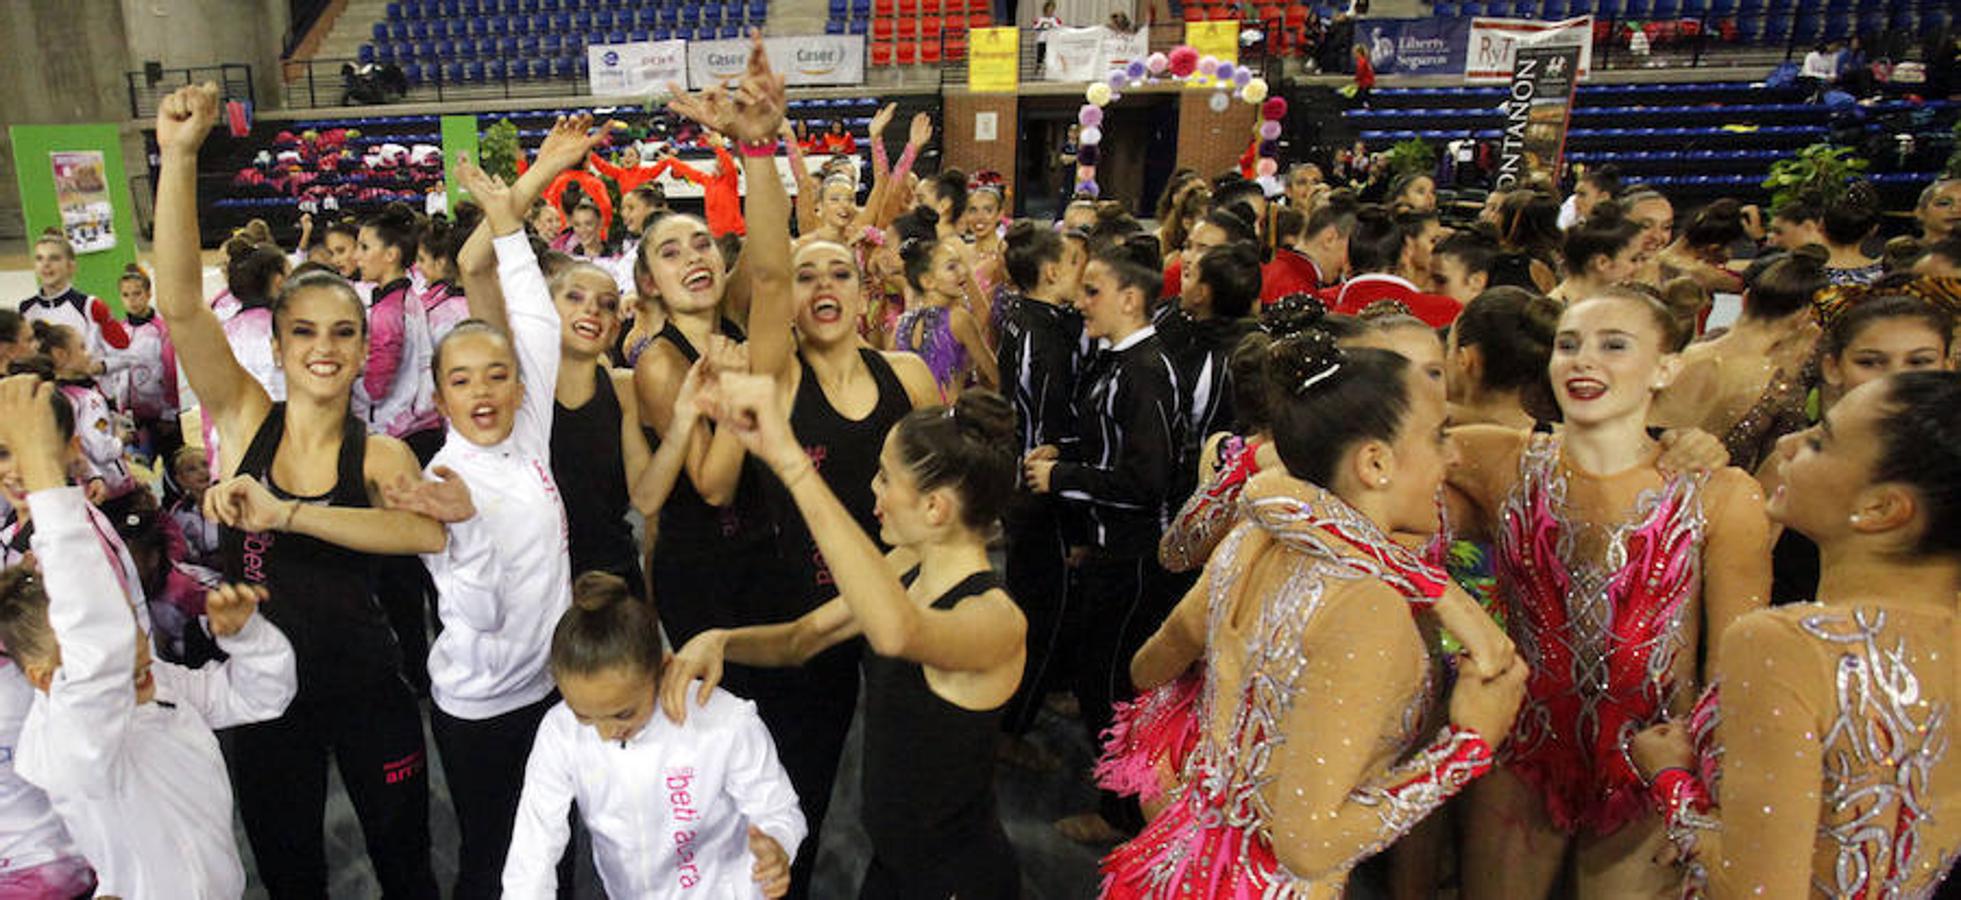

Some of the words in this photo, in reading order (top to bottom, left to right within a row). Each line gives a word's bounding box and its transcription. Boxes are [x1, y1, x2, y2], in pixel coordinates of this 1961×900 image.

[1397, 36, 1445, 50] Liberty
[796, 49, 835, 63] Caser
[1479, 36, 1515, 68] RyT
[1397, 55, 1448, 71] Seguros
[667, 775, 700, 822] beti
